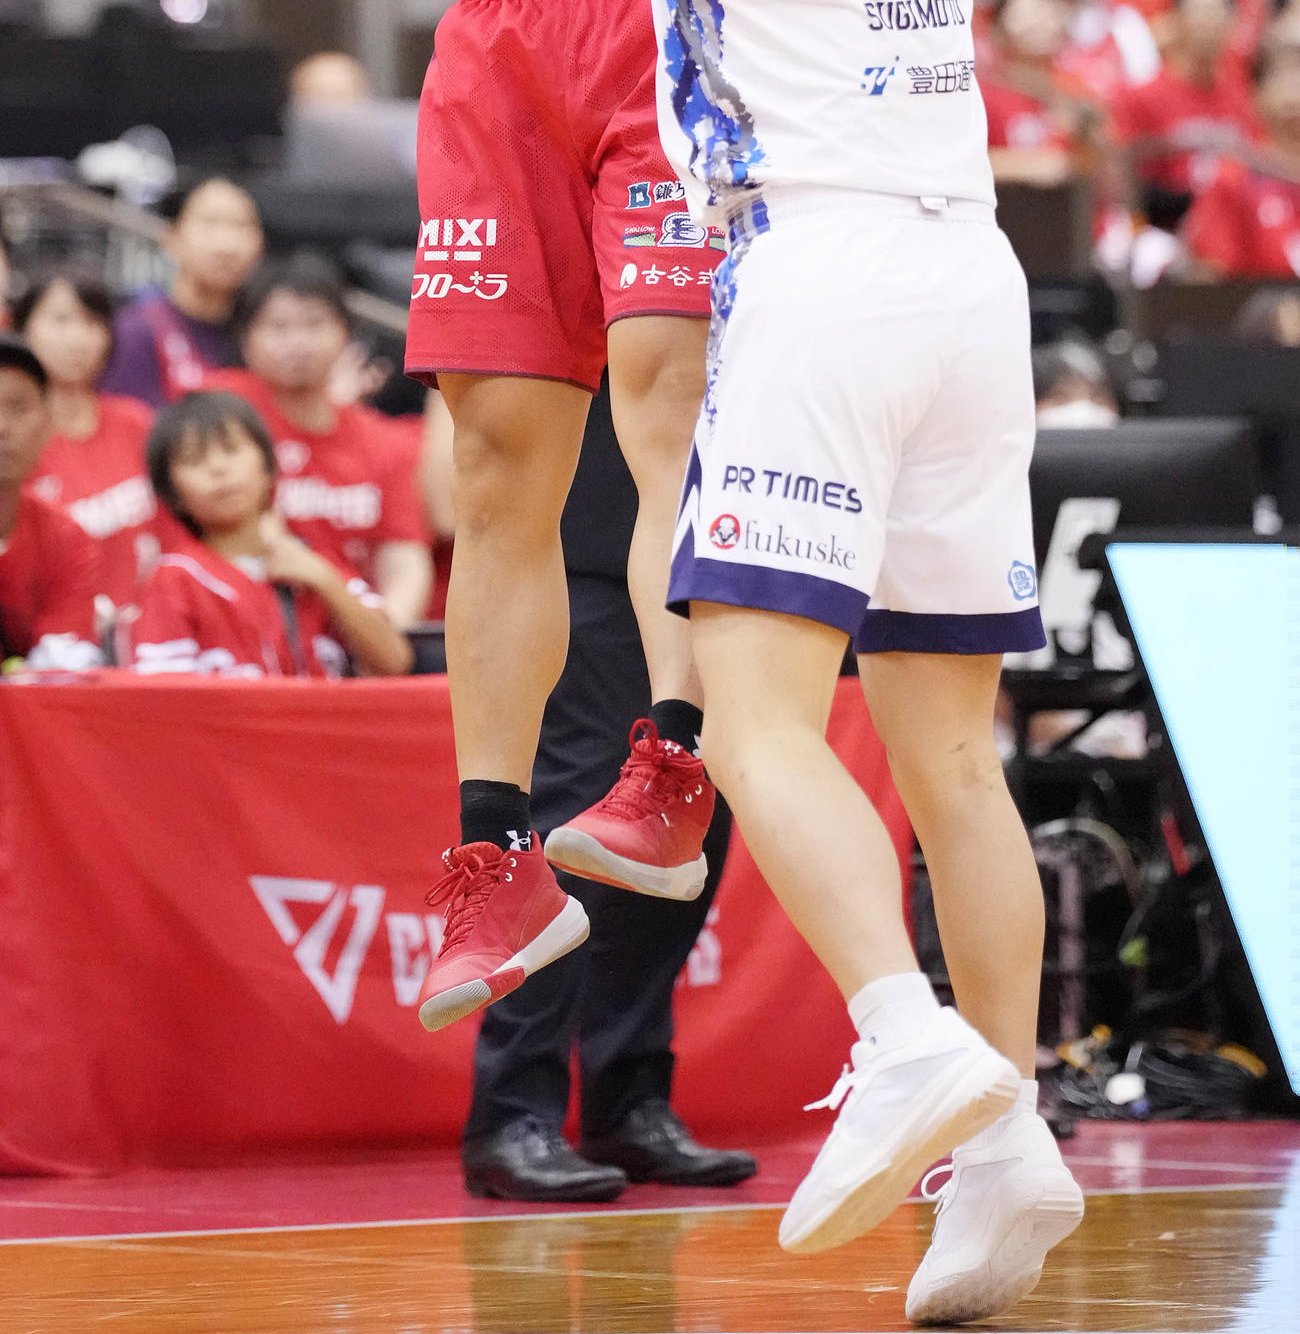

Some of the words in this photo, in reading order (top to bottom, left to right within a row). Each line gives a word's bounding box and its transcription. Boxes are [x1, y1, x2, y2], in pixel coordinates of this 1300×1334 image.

[419, 218, 497, 248] MIXI
[722, 465, 756, 494] PR
[762, 470, 863, 514] TIMES
[745, 519, 857, 571] fukuske
